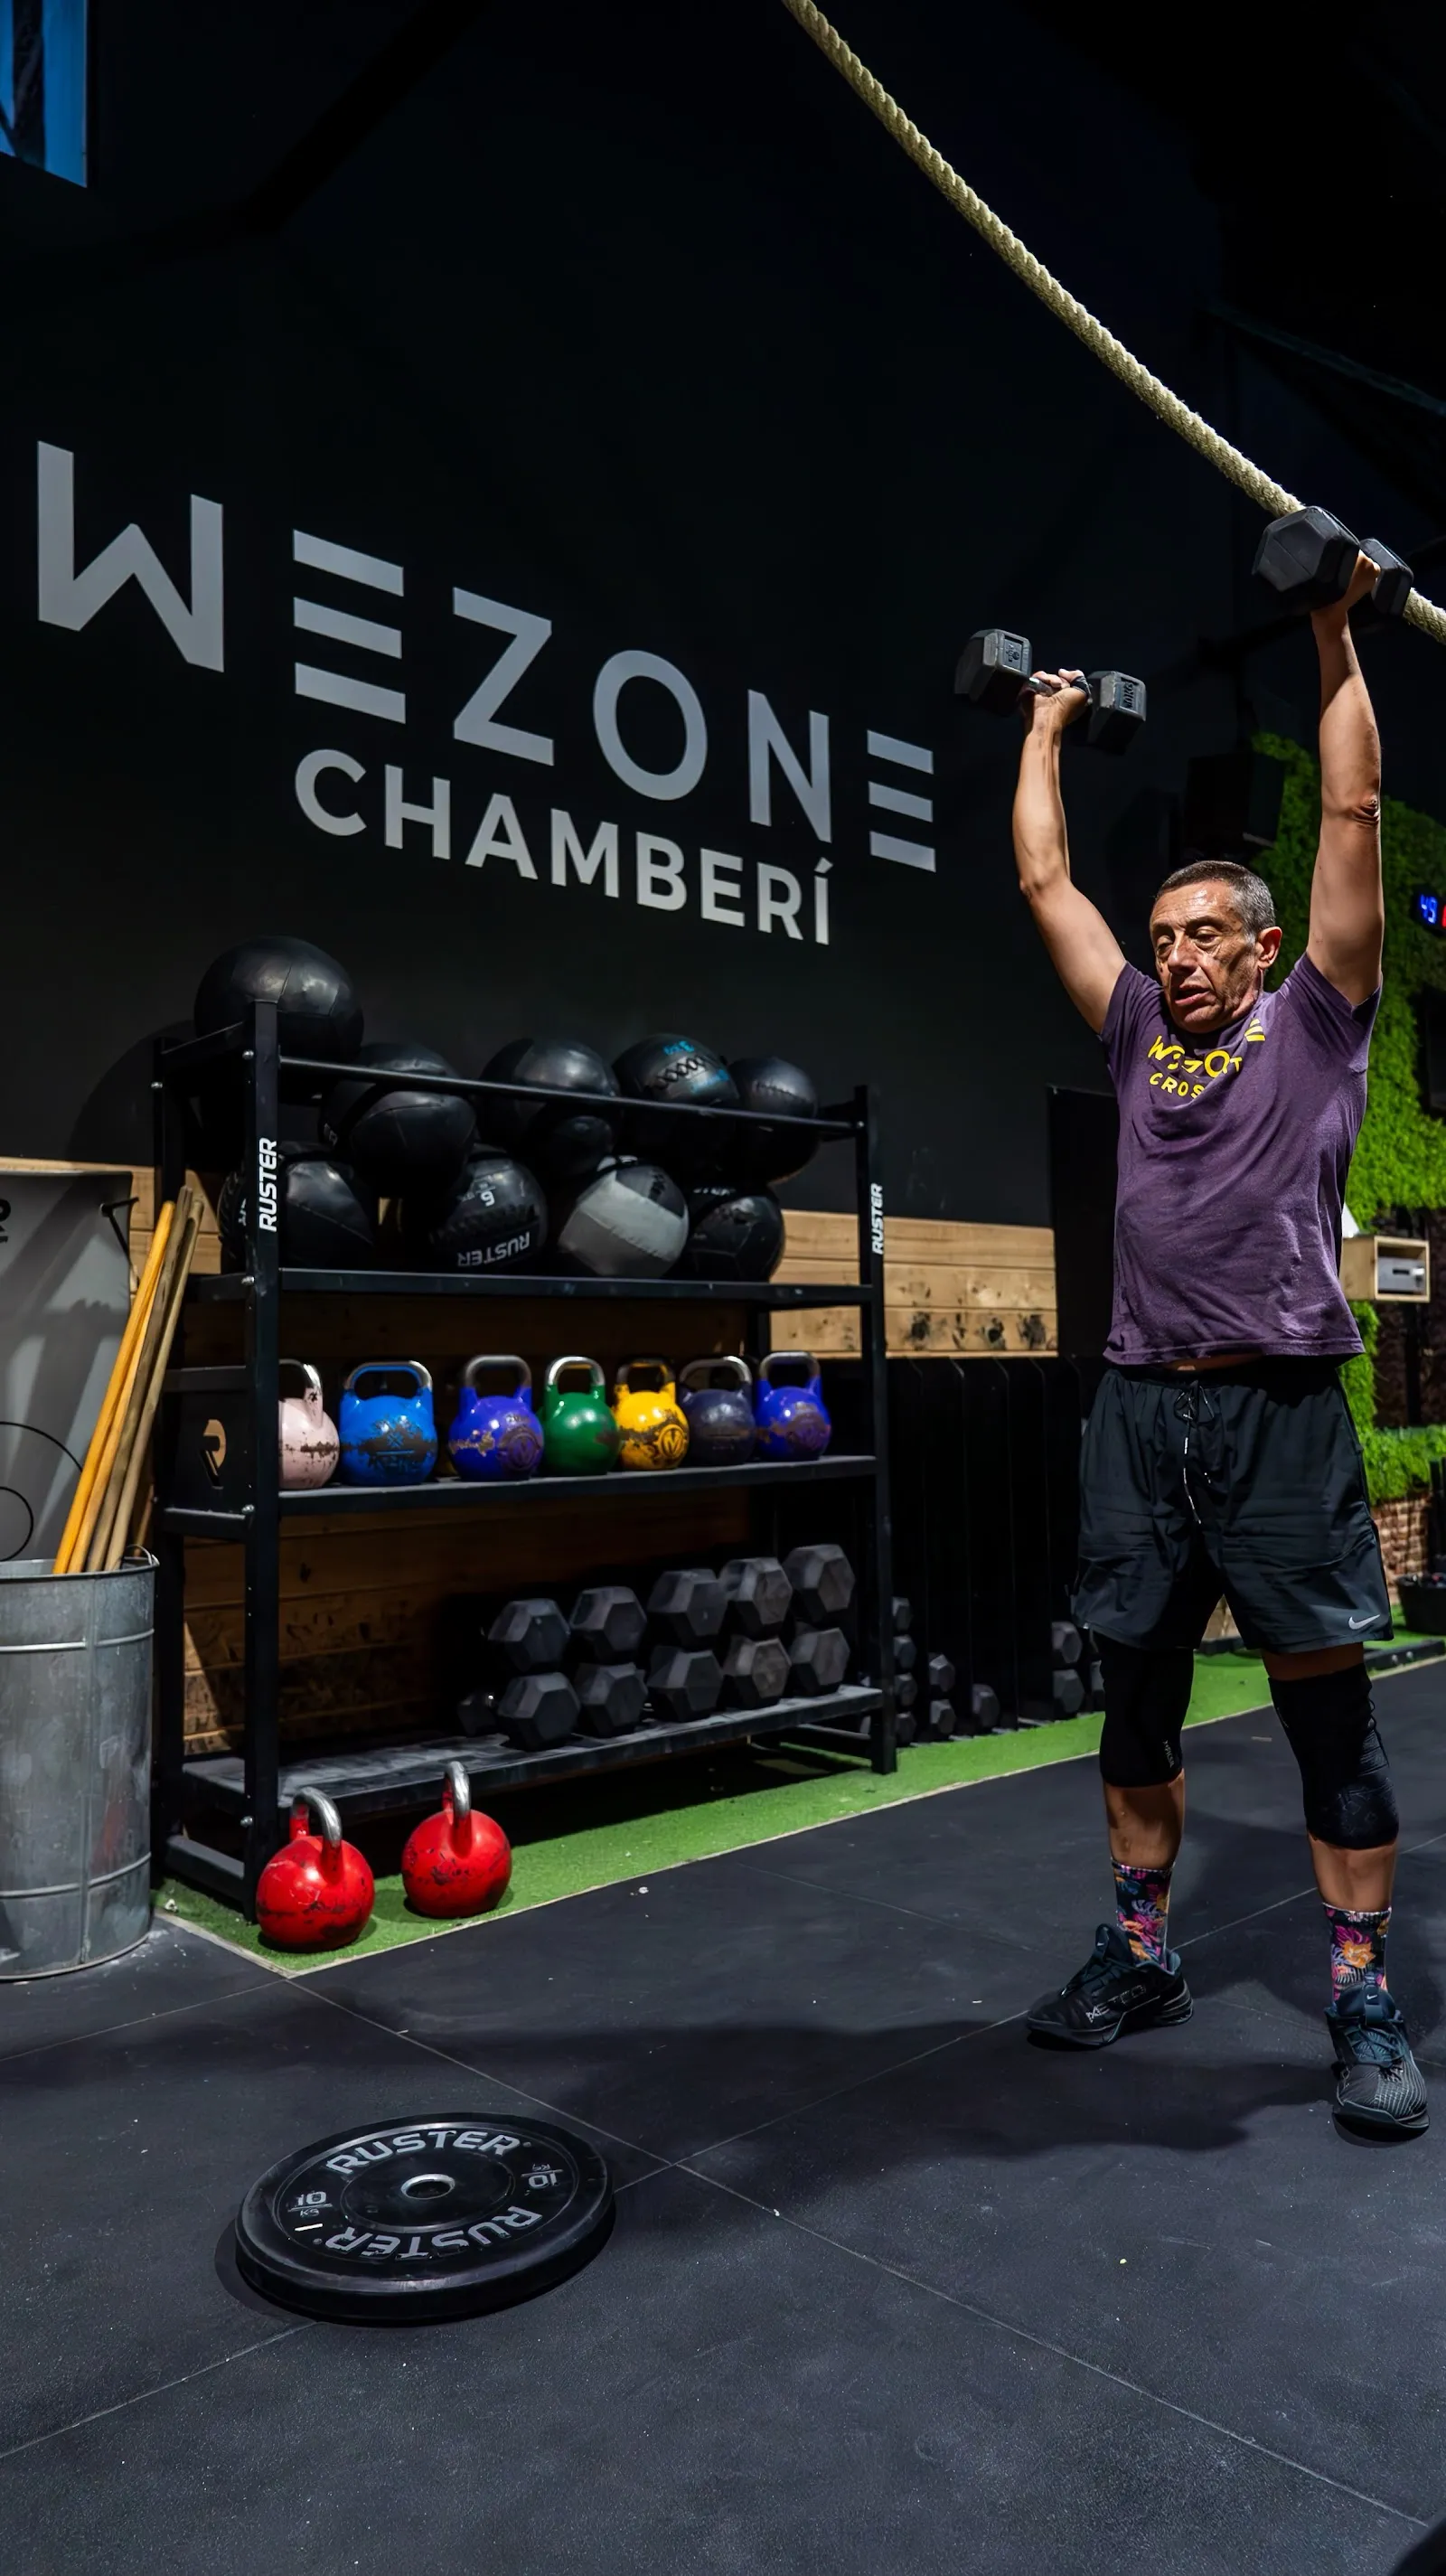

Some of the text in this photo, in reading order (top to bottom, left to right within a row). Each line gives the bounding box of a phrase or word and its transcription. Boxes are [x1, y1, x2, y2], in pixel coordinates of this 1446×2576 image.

[38, 440, 936, 873] WEZONE
[295, 749, 833, 945] CHAMBERÍ
[258, 1137, 277, 1233] RUSTER
[870, 1183, 884, 1255] RUSTER
[456, 1231, 531, 1268] RUSTER
[325, 2130, 521, 2175] RUSTER
[325, 2205, 543, 2261] RUSTER
